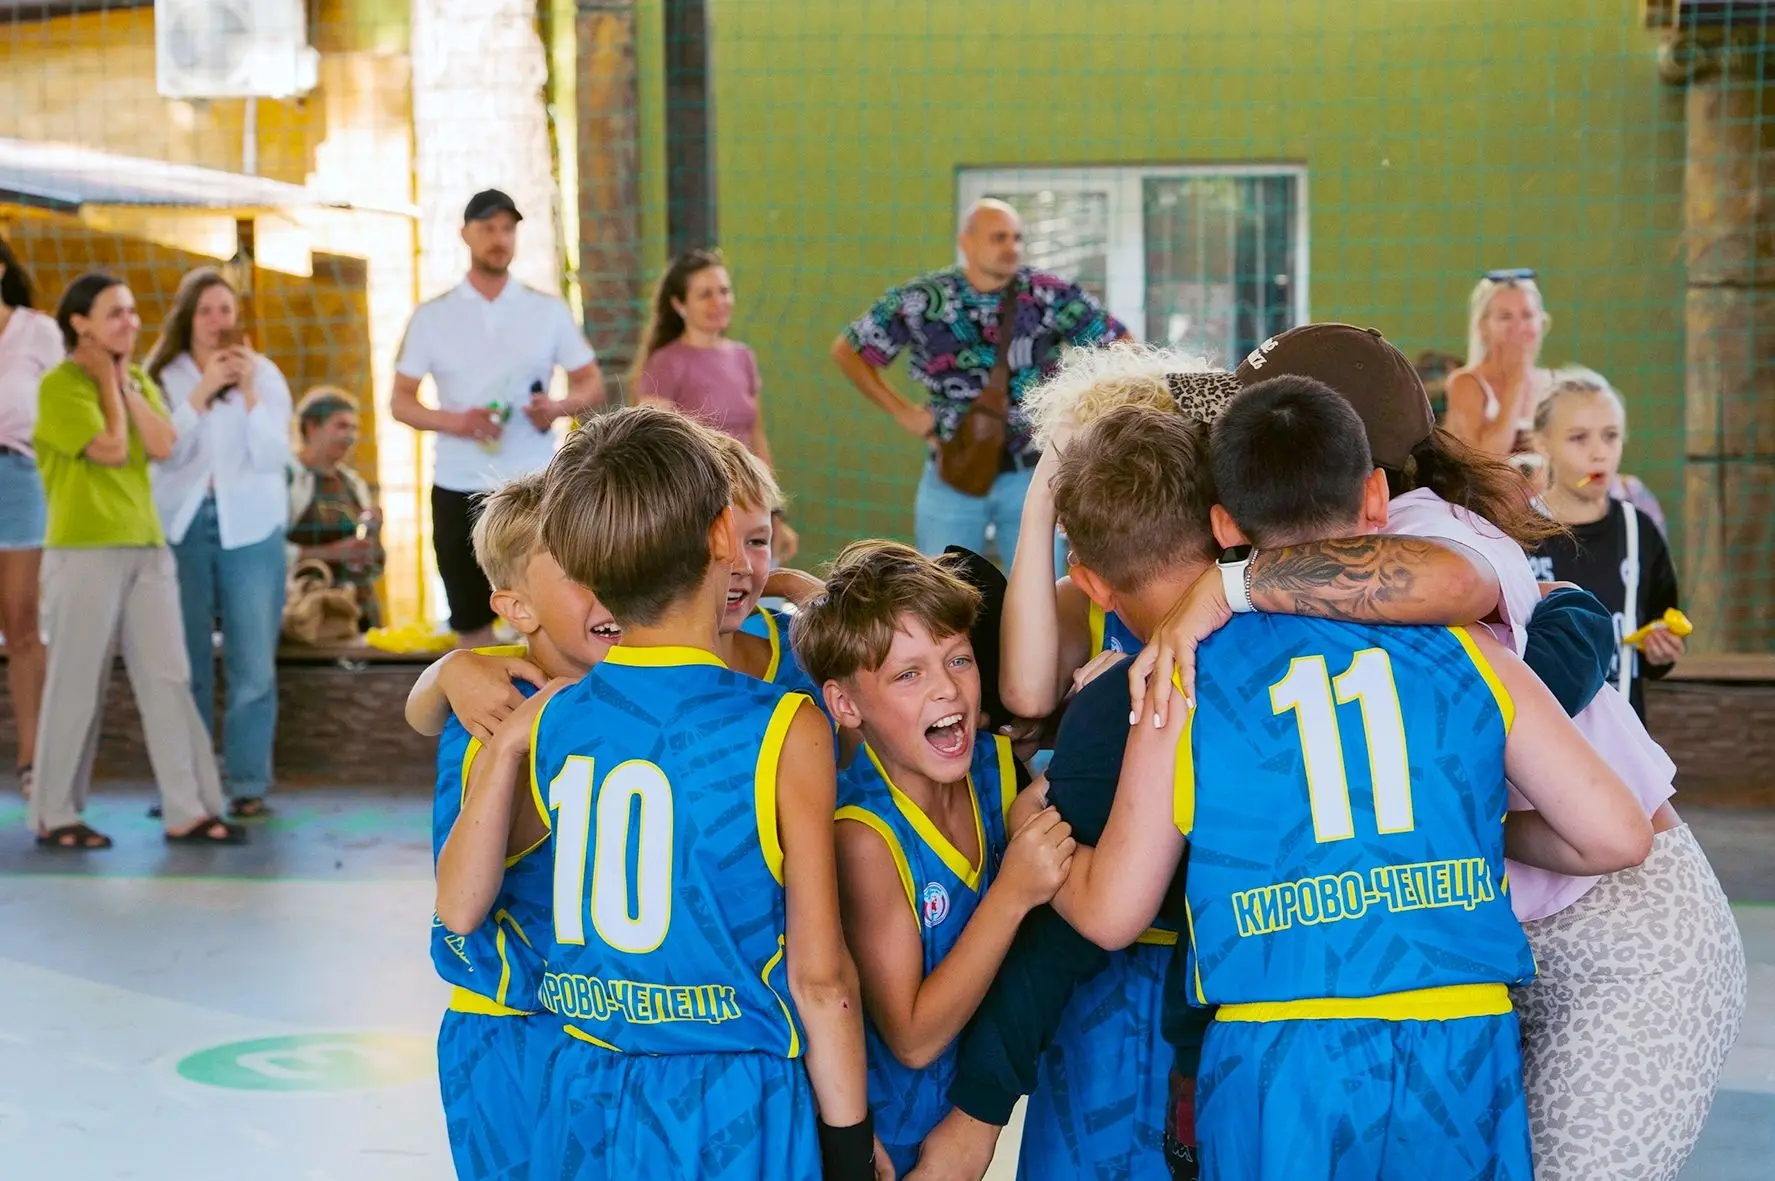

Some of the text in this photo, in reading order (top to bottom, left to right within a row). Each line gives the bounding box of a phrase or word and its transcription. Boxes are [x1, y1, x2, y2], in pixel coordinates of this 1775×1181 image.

[1269, 647, 1414, 844] 11
[548, 754, 674, 954] 10
[1232, 858, 1494, 937] КИРОВО-ЧЕПЕЦК
[538, 972, 742, 1024] РОВО-ЧЕПЕЦК
